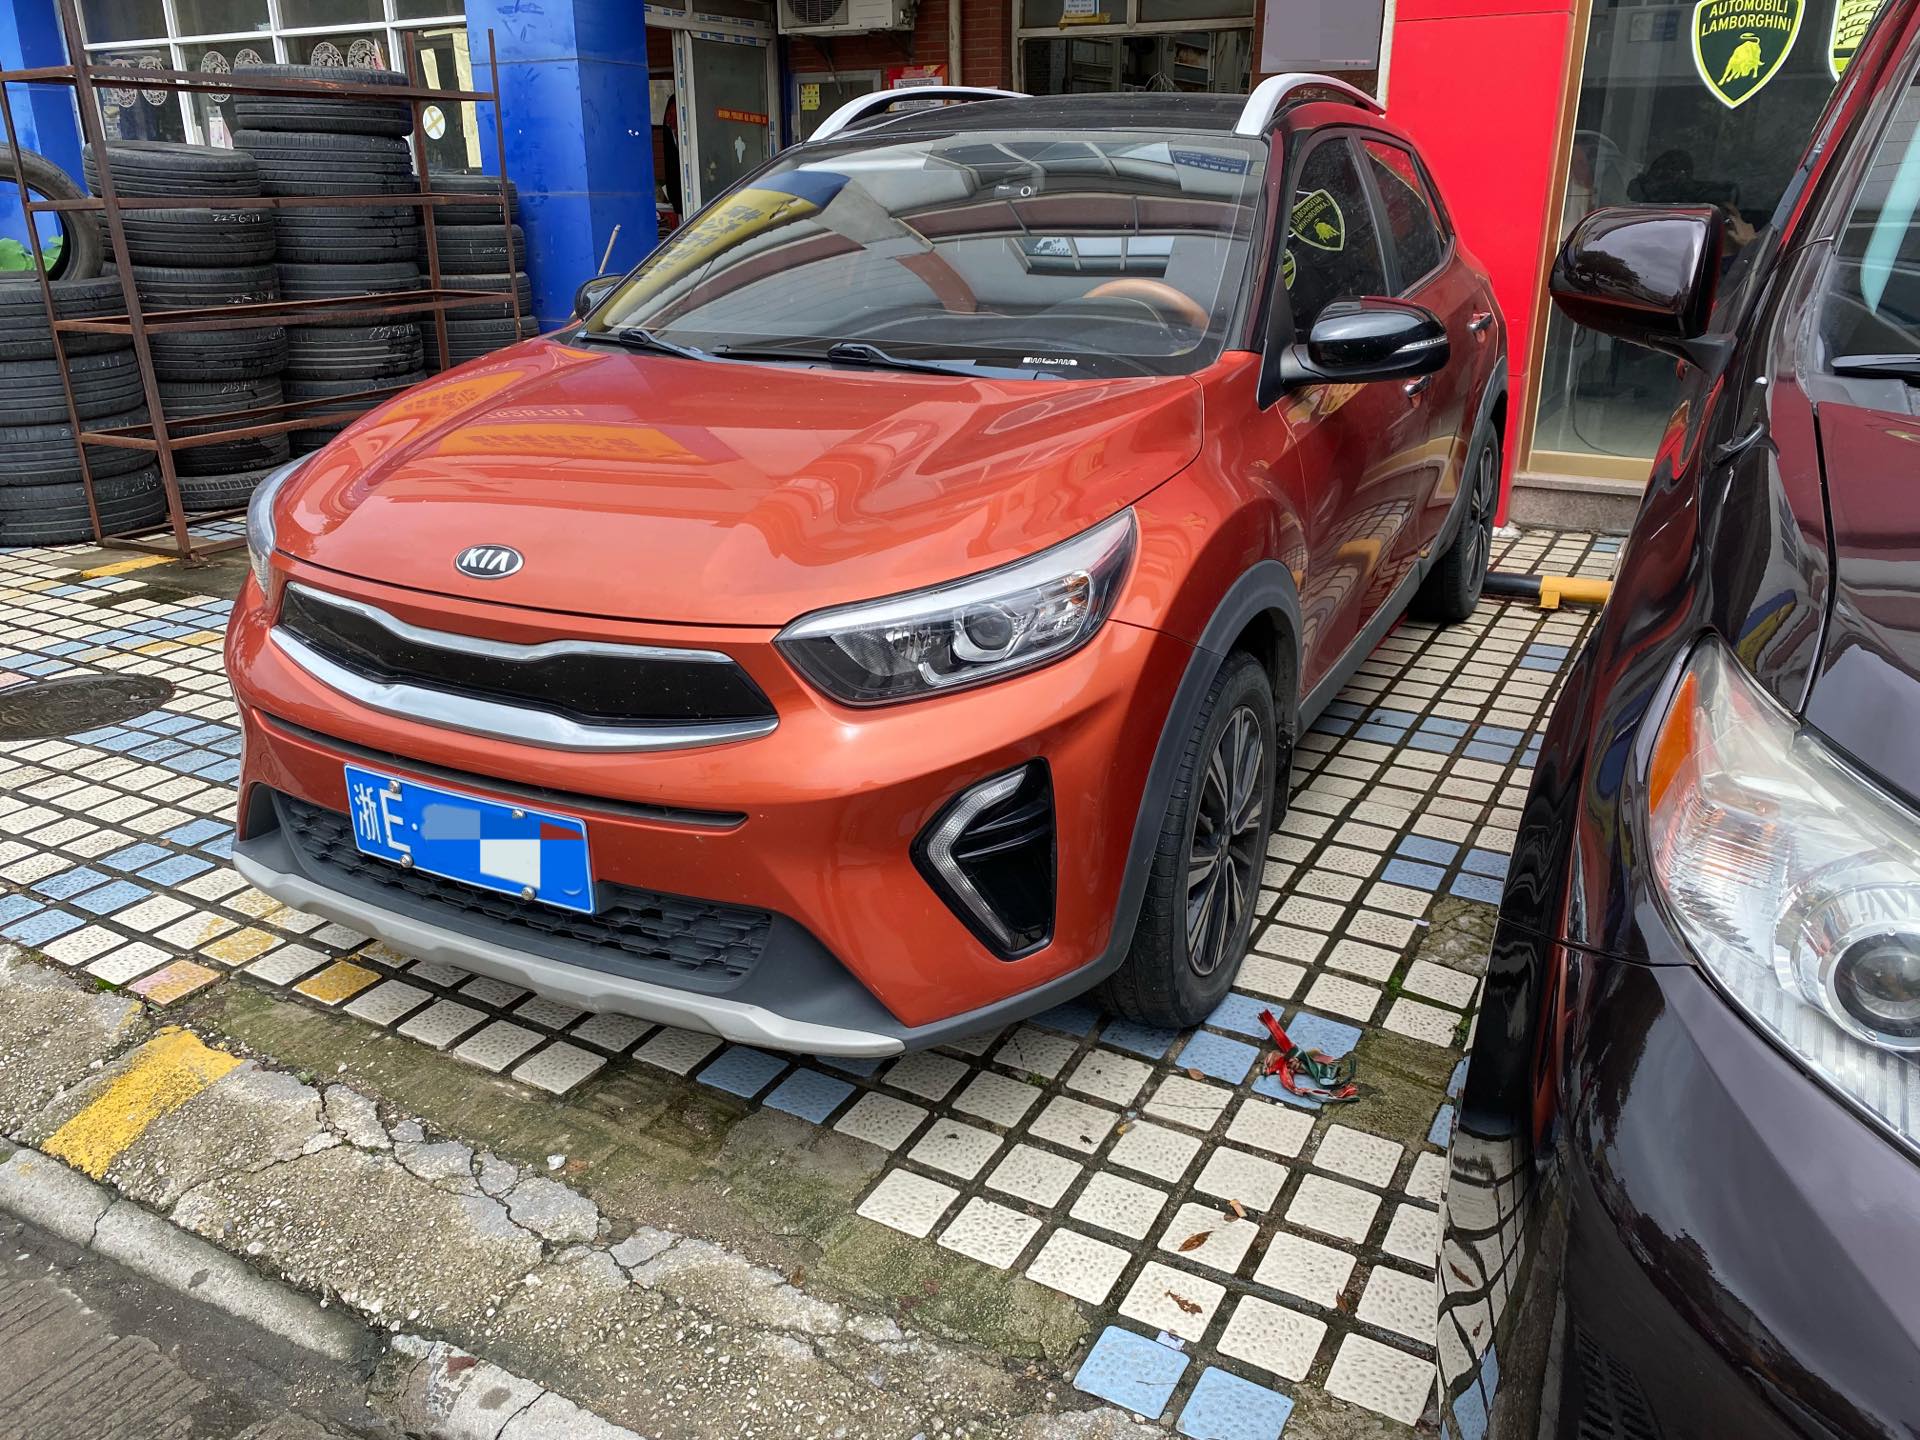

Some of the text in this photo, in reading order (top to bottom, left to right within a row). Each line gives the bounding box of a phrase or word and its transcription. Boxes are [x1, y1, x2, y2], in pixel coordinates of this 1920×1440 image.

[1709, 0, 1788, 18] AUTOMOBILI
[1701, 14, 1792, 37] LAMBORGHINI
[461, 548, 511, 572] KIA
